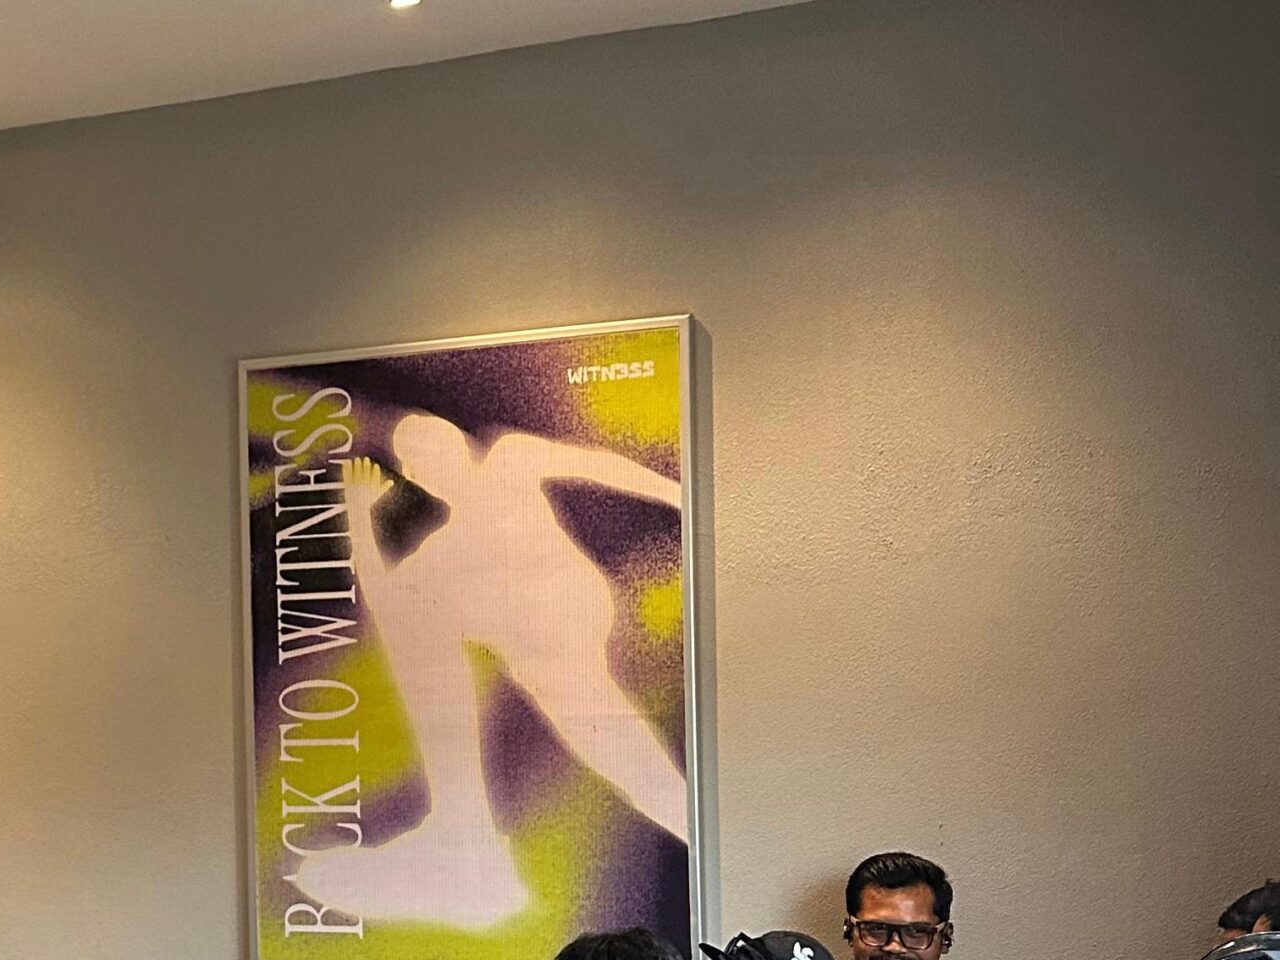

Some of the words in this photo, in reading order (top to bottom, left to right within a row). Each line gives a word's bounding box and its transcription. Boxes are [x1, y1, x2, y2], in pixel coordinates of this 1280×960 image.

[272, 387, 358, 665] WITNESS
[279, 679, 360, 762] TO
[282, 775, 363, 939] BCK
